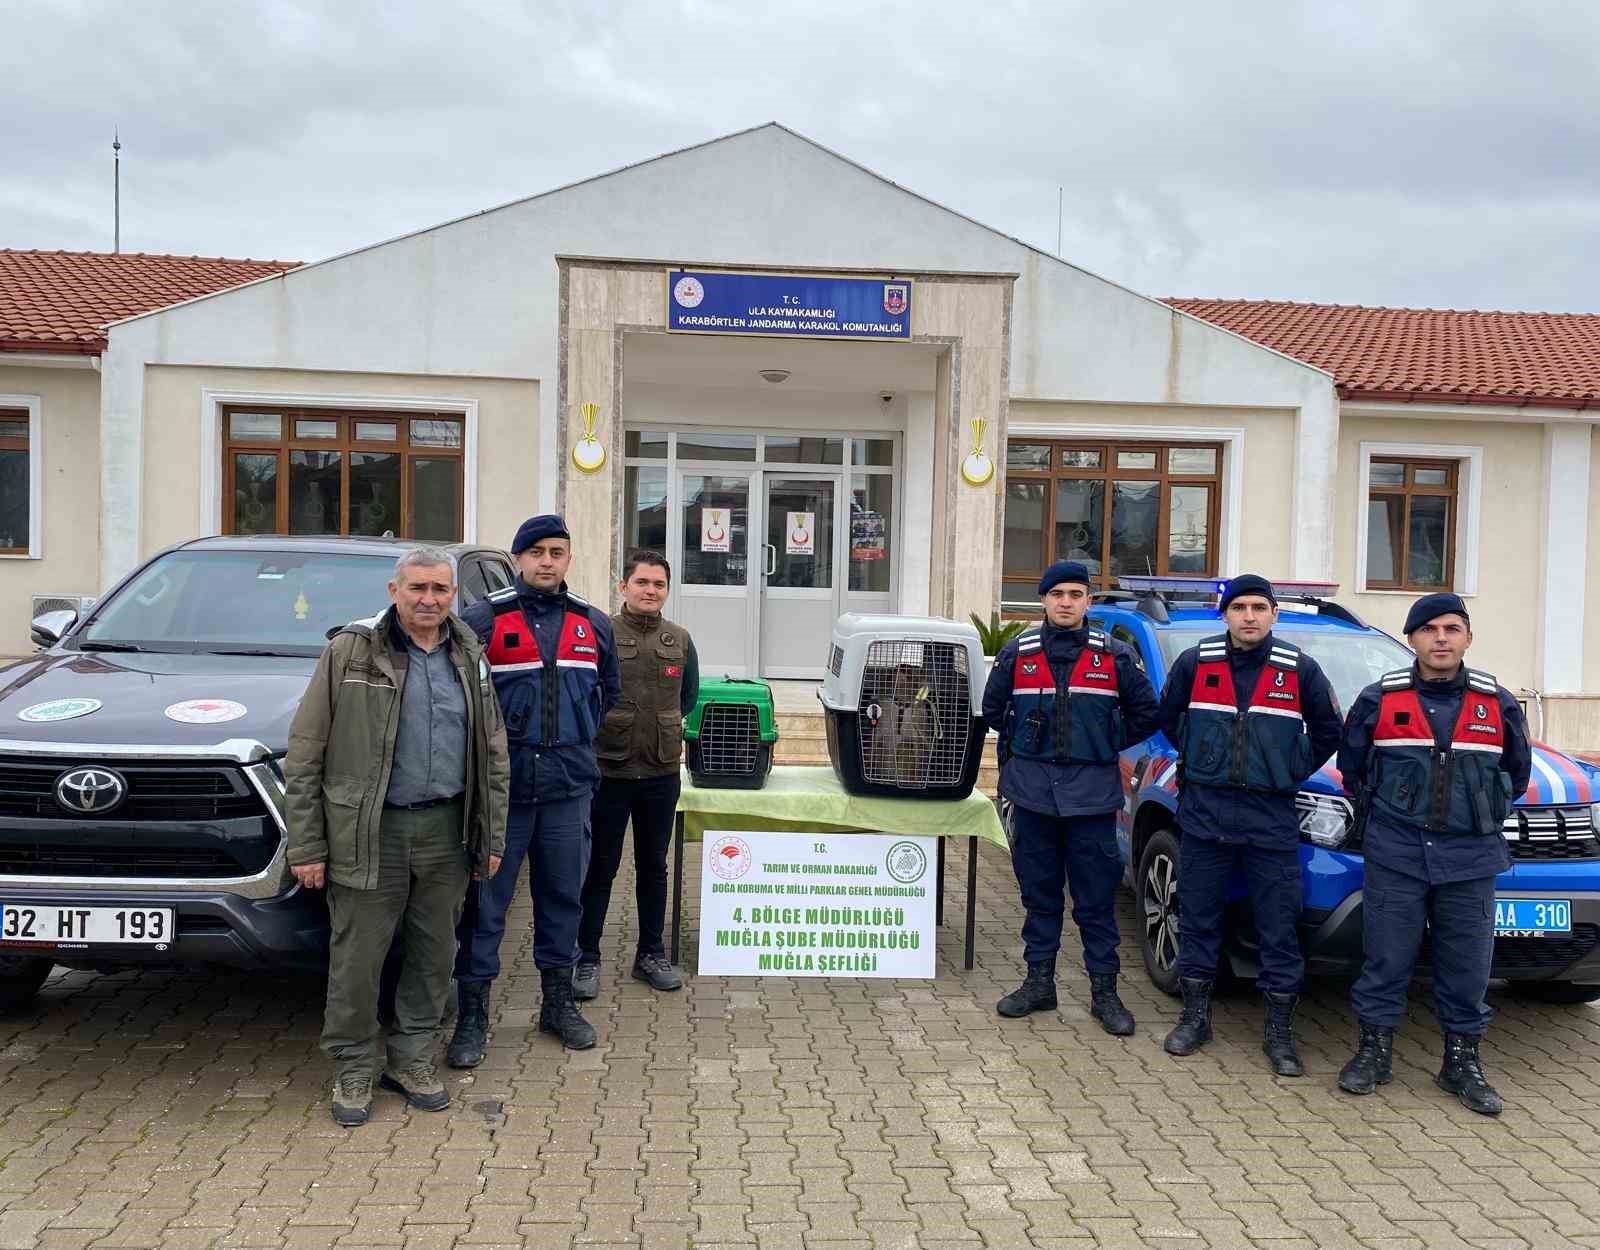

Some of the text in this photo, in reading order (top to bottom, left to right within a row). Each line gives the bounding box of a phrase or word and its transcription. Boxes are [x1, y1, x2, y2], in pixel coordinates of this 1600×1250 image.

[748, 306, 767, 316] ULA
[678, 315, 746, 327] KARABÖRTLEN
[747, 319, 797, 329] JANDARMA
[798, 320, 841, 331] KARAKOL
[763, 863, 789, 873] TARIM
[790, 863, 801, 874] VE
[802, 864, 832, 874] ORMAN
[737, 883, 773, 894] KORUMA
[774, 884, 785, 894] VE
[809, 885, 847, 896] PARKLAR
[848, 886, 873, 896] GENEL
[4, 908, 164, 939] 32 HT 193
[732, 905, 904, 926] 4. BÖLGE MÜDÜRLÜĞÜ
[1535, 903, 1567, 927] 310
[716, 927, 920, 950] MUĞLA ŞUBE MÜDÜRLÜĞÜ
[758, 951, 877, 974] MUĞLA ŞEFLİĞİ
